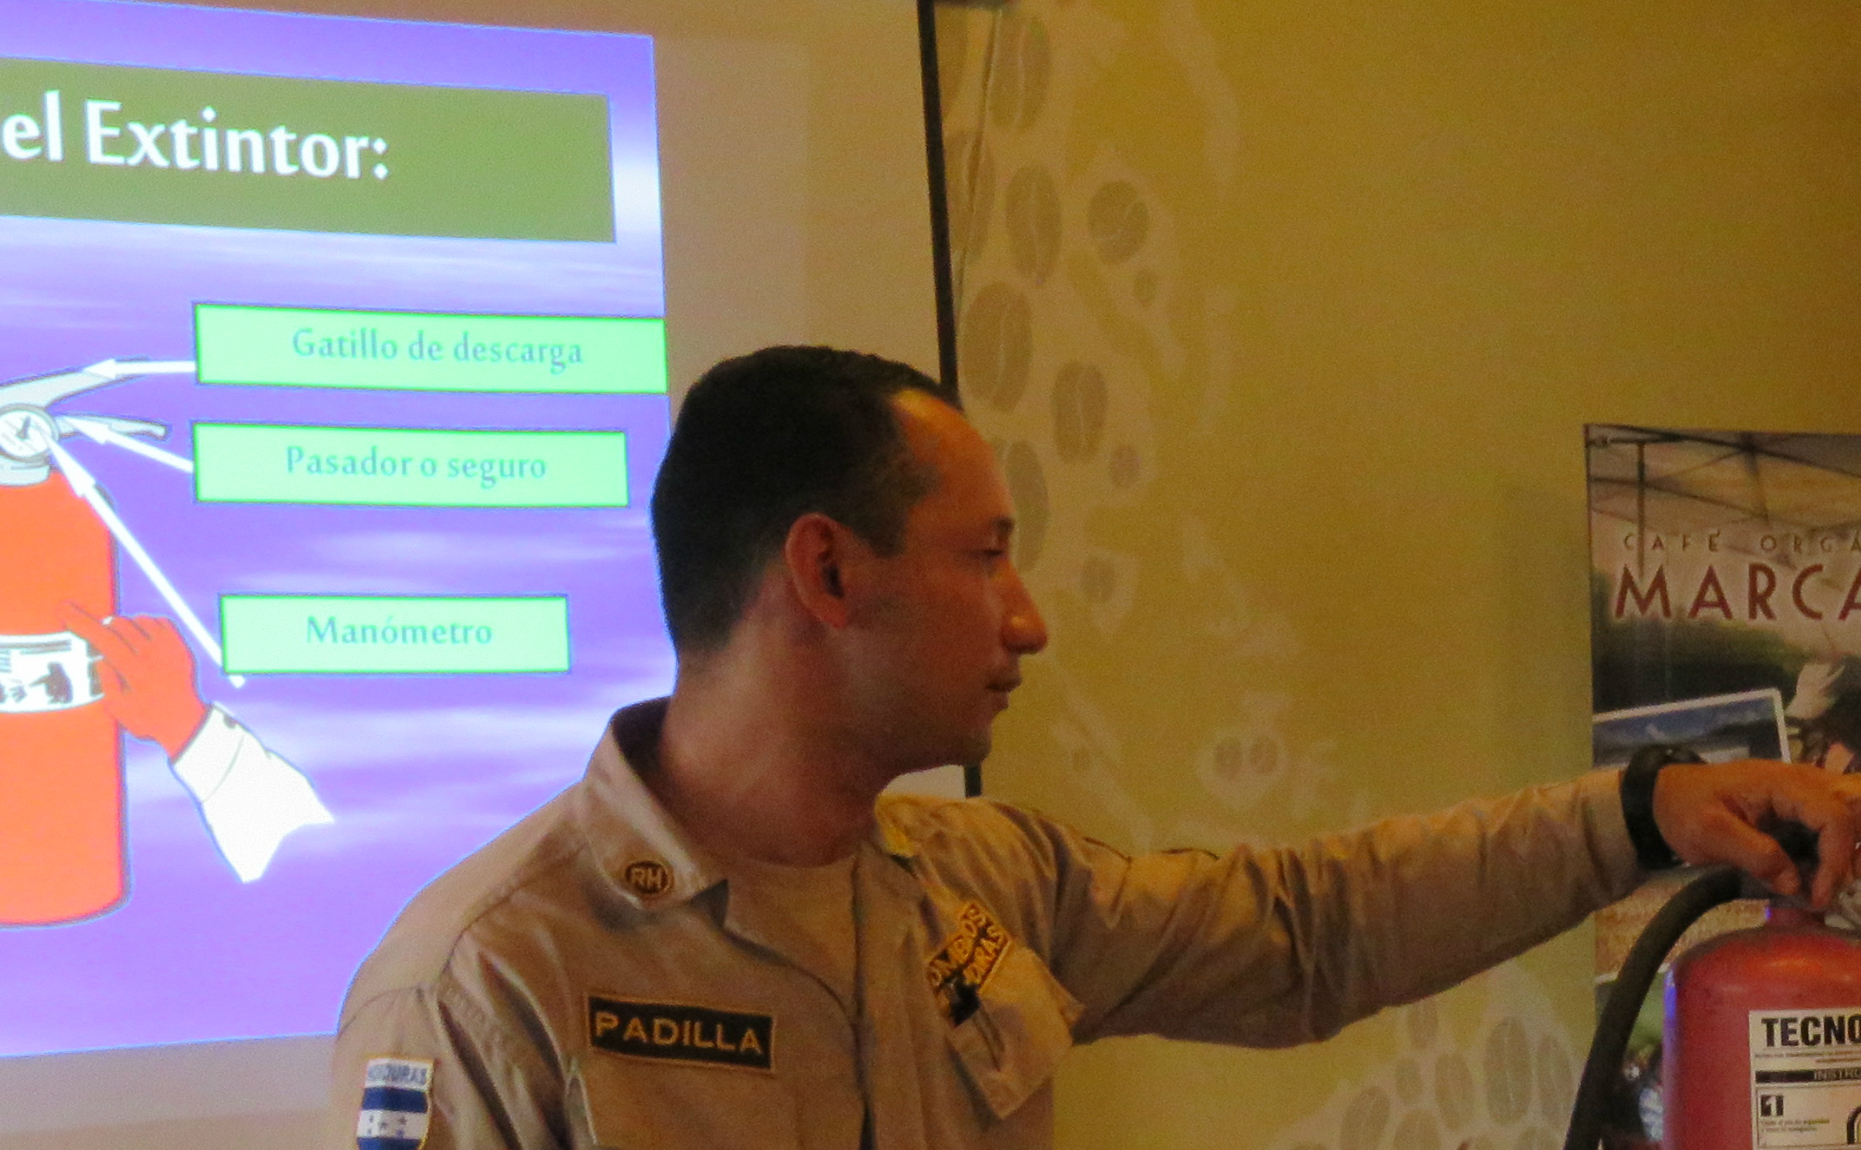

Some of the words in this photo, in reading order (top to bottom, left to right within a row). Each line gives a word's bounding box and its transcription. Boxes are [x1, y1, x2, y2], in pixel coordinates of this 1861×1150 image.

[2, 88, 62, 163] el
[86, 99, 391, 180] Extintor:
[292, 327, 399, 362] Gatillo
[409, 331, 444, 361] de
[454, 335, 584, 375] descarga
[286, 445, 413, 478] Pasador
[420, 458, 437, 476] o
[447, 456, 547, 488] seguro
[1623, 528, 1721, 554] CAFÉ
[306, 614, 493, 645] Manómetro
[594, 1012, 764, 1054] PADILLA
